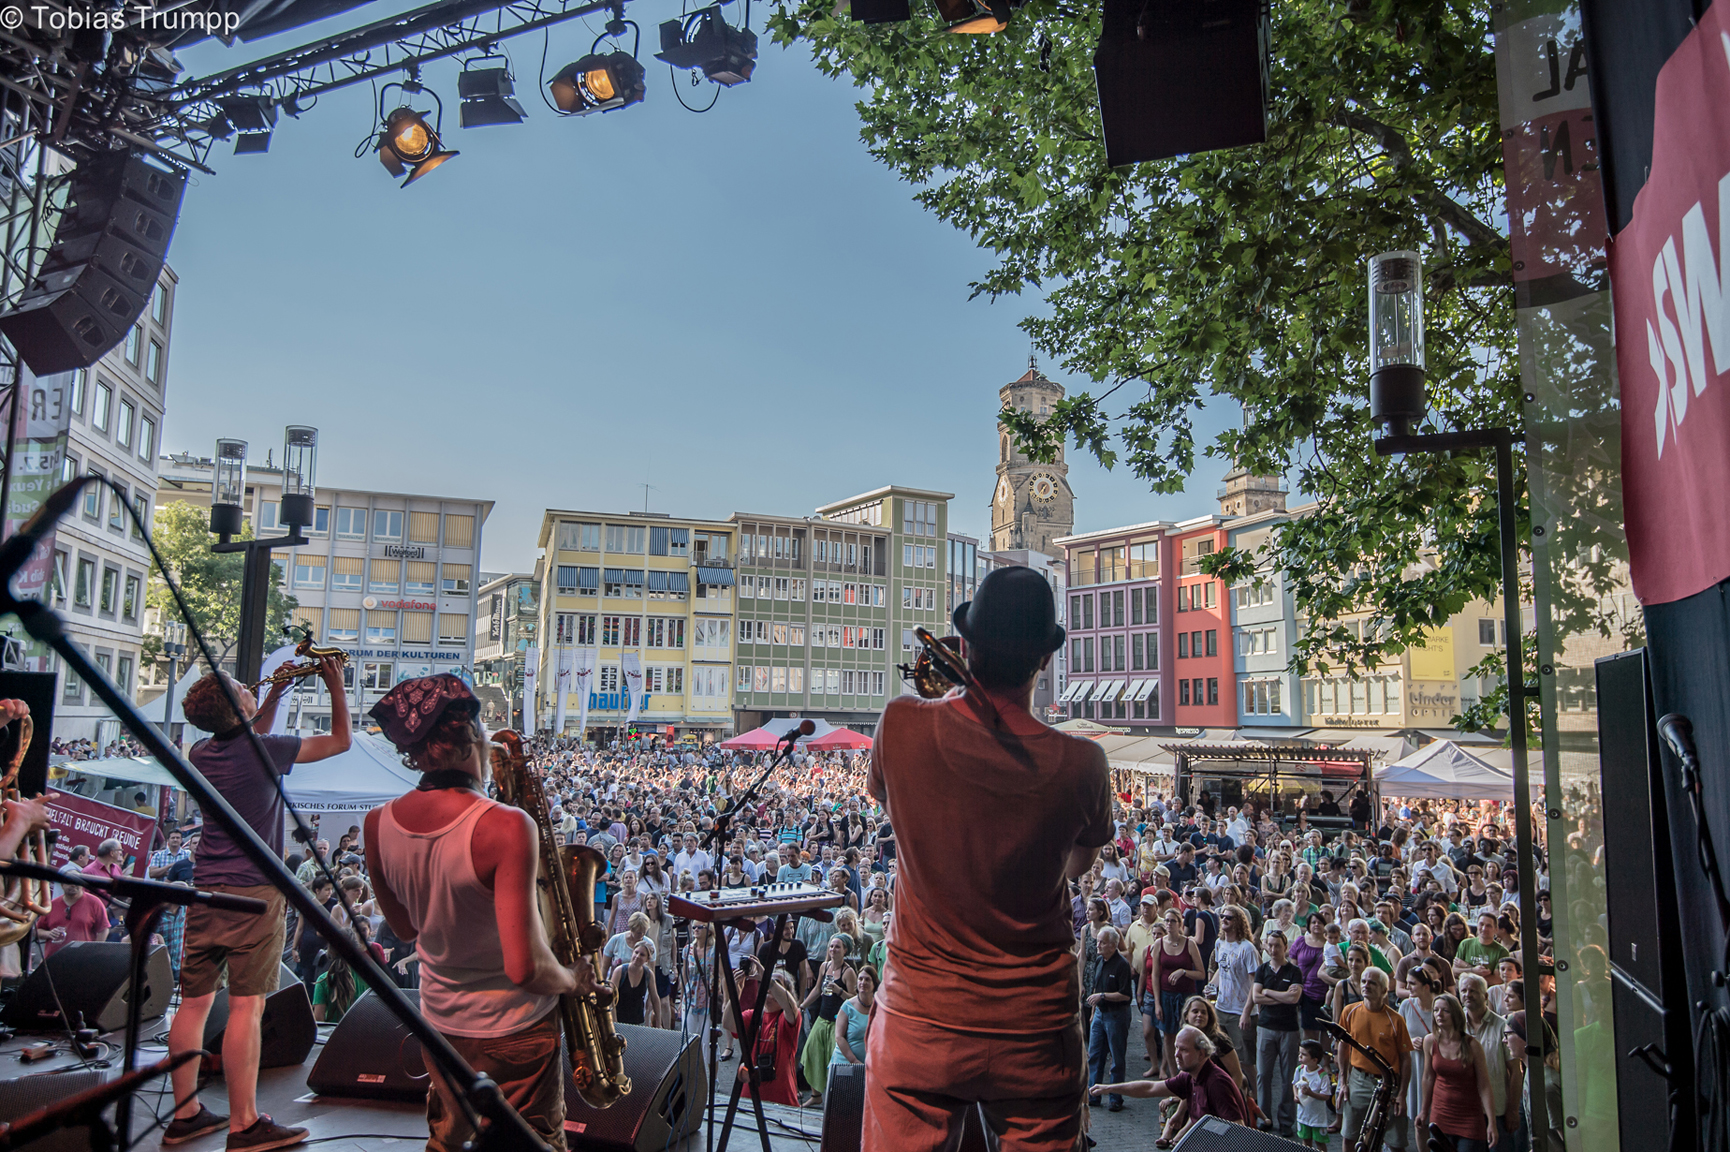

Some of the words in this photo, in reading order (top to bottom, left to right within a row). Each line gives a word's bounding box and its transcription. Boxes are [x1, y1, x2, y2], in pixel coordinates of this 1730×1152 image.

[381, 599, 437, 610] vodafone
[377, 650, 399, 658] DER
[402, 651, 460, 660] KULTUREN
[1410, 691, 1456, 705] binder
[74, 817, 110, 838] BRAUCHT
[111, 828, 142, 850] FREUNDE
